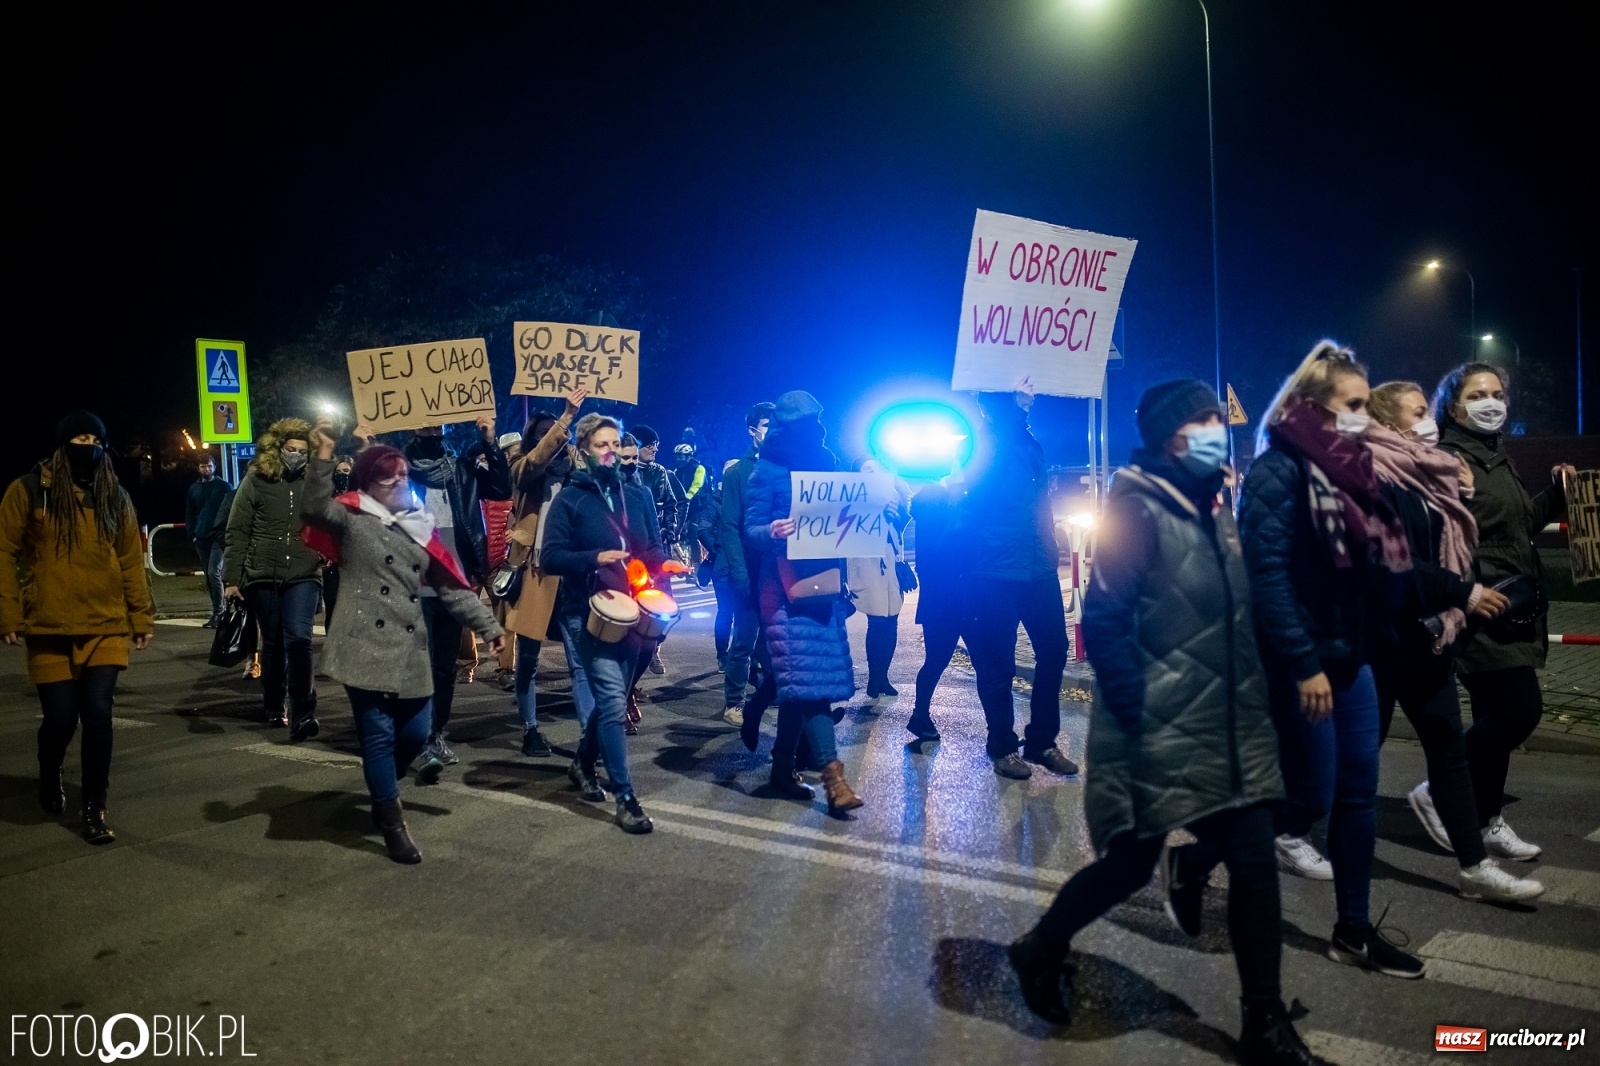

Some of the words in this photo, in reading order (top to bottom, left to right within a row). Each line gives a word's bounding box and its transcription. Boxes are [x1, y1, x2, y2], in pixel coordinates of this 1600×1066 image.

[977, 237, 999, 275] W
[1009, 242, 1118, 292] OBRONIE
[519, 327, 552, 351] GO
[565, 328, 635, 354] DUCK
[973, 297, 1097, 351] WOLNOŚCI
[357, 350, 414, 384] JEJ
[426, 347, 485, 374] CIAŁO
[524, 372, 610, 395] JAREK
[363, 390, 412, 421] JEJ
[421, 377, 493, 412] WYBÓR
[800, 479, 868, 504] WOLNA
